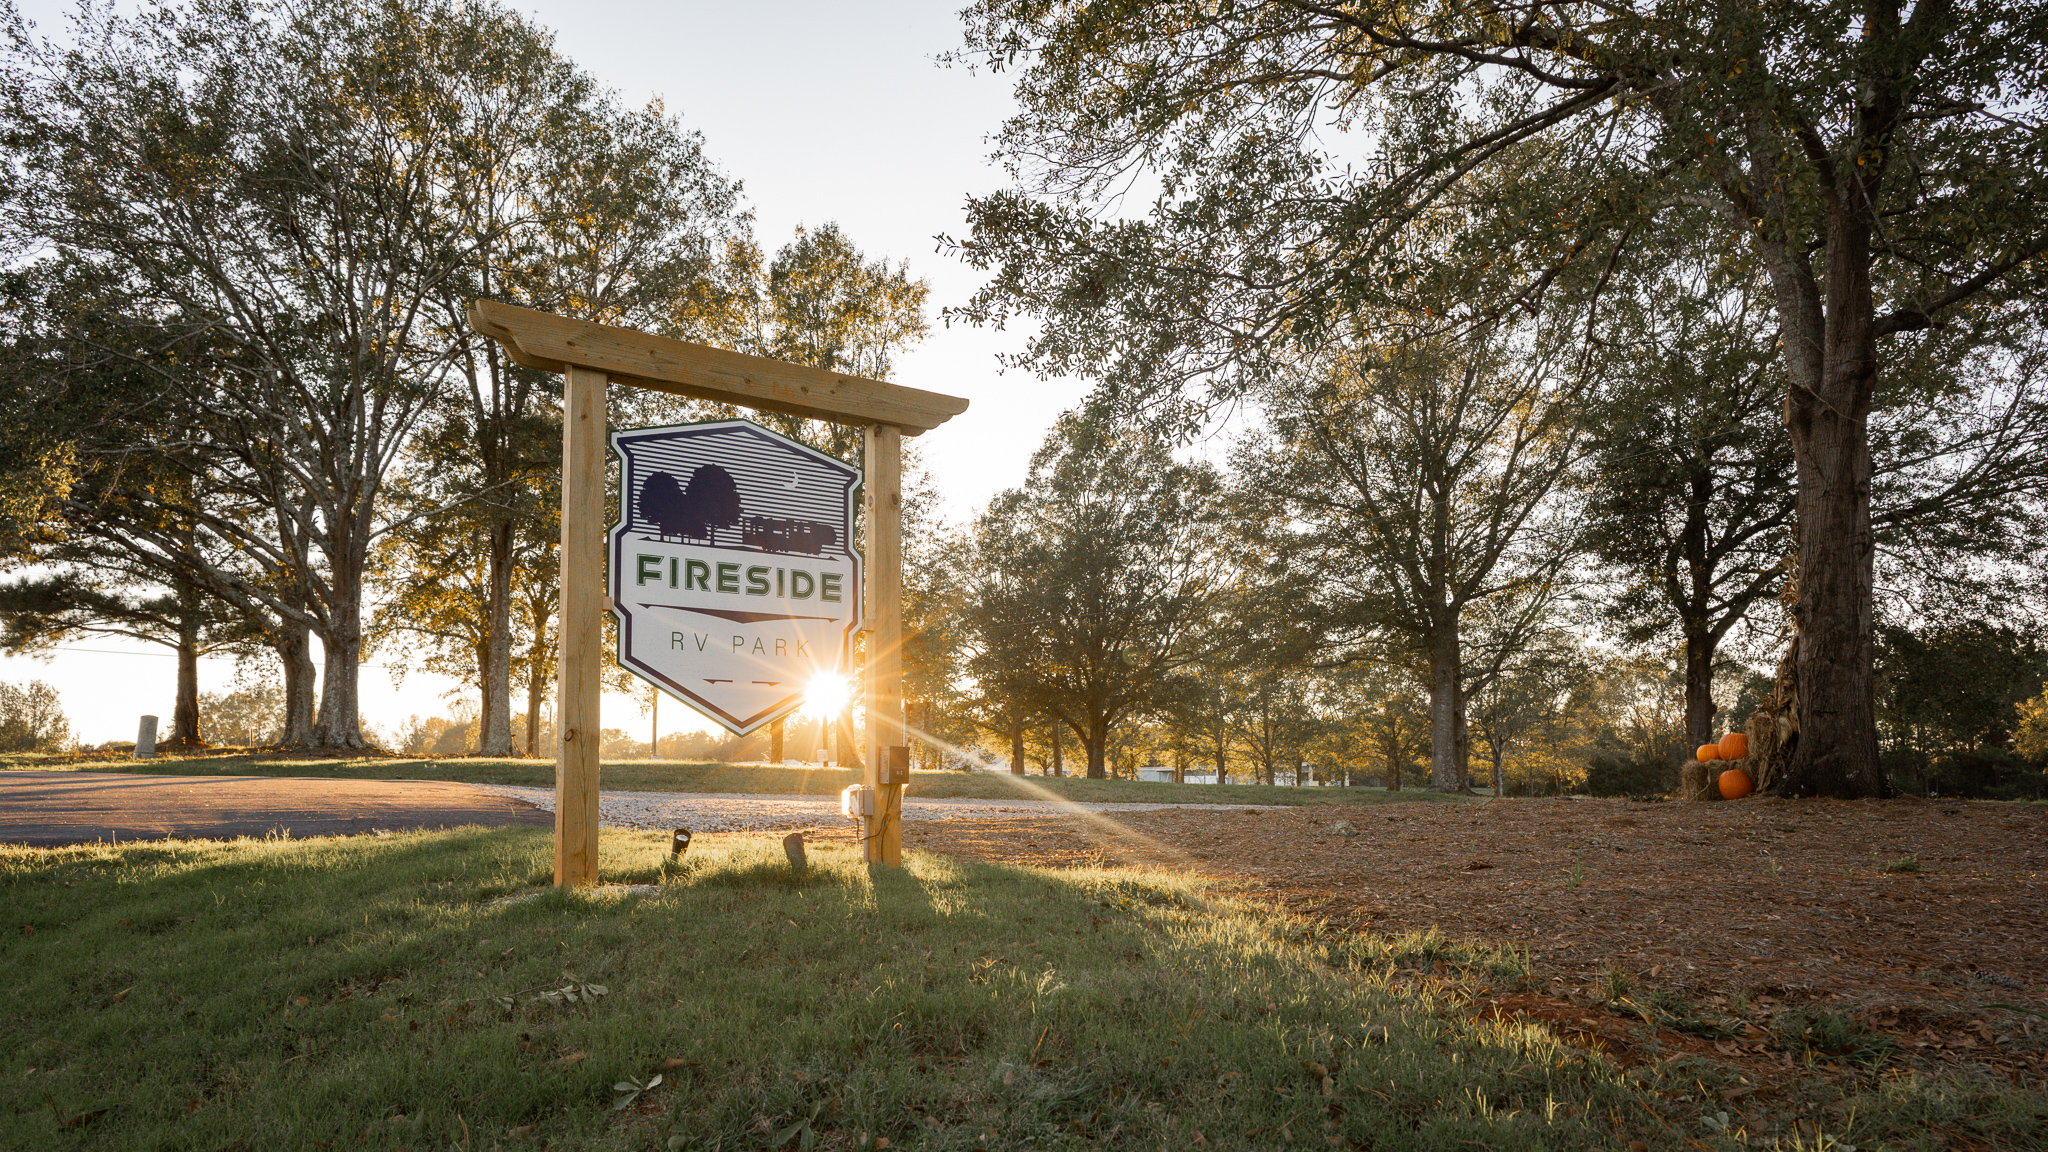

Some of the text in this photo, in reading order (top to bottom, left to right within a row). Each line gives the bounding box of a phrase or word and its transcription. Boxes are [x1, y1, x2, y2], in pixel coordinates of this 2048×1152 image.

[636, 553, 844, 603] FIRESIDE
[671, 631, 809, 658] RV PARK
